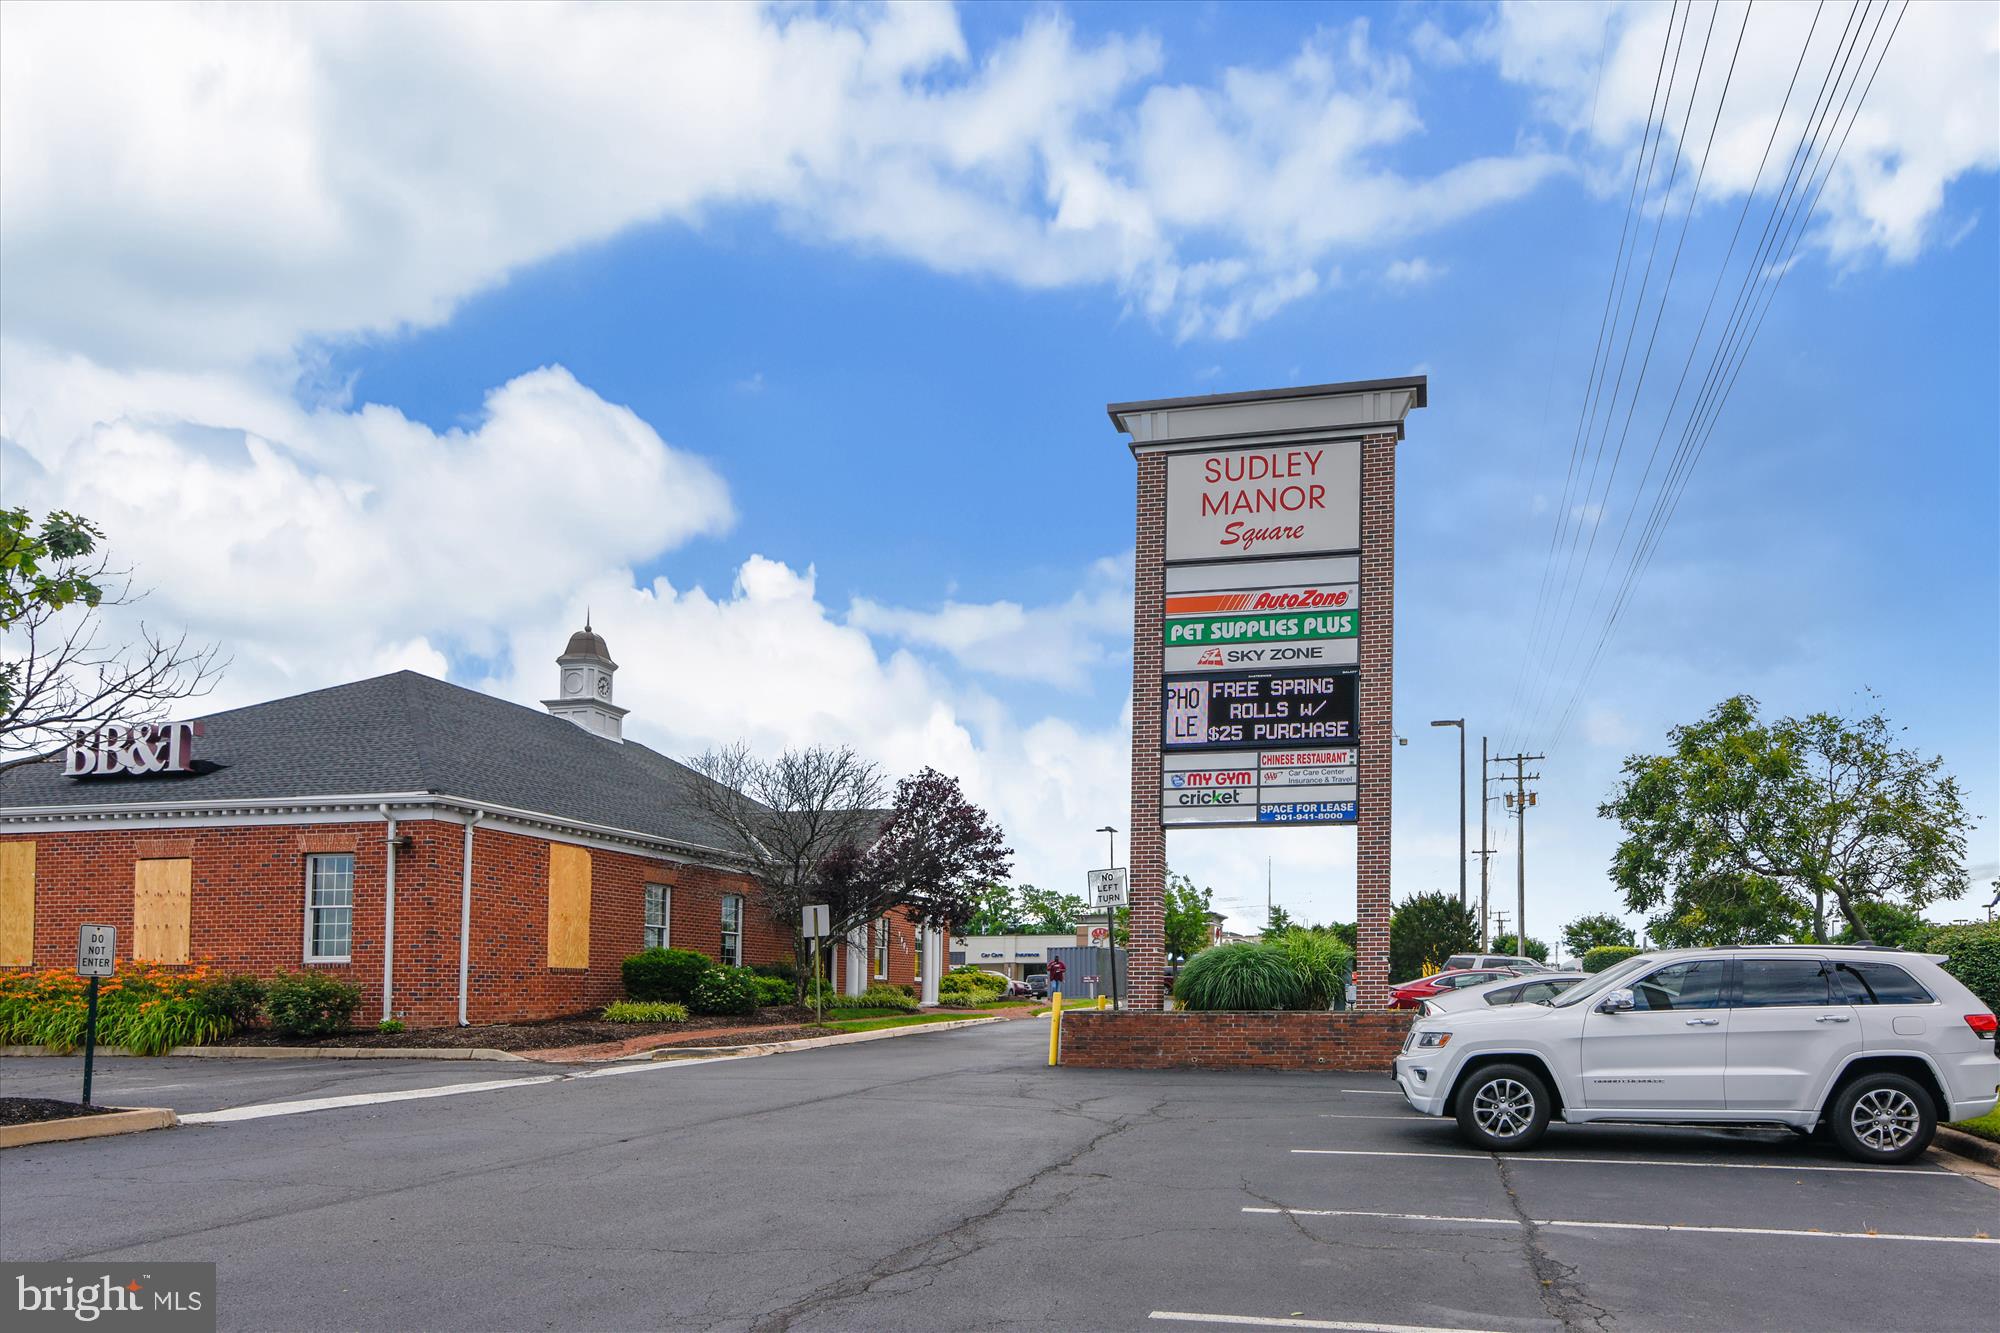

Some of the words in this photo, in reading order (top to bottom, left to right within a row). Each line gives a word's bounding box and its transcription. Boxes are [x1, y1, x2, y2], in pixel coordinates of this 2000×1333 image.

[1204, 450, 1324, 484] SUDLEY
[1201, 485, 1326, 517] MANOR
[1219, 521, 1305, 550] Square
[1252, 589, 1349, 610] AutoZone
[1170, 623, 1205, 642] PET
[1210, 618, 1299, 639] SUPPLIES
[1303, 615, 1352, 635] PLUS
[1227, 649, 1265, 662] SKY
[1269, 647, 1323, 661] ZONE
[1212, 681, 1259, 698] FREE
[1270, 677, 1334, 696] SPRING
[1167, 687, 1200, 710] PHO
[1230, 702, 1289, 719] ROLLS
[1175, 715, 1198, 737] LE
[1208, 725, 1243, 742] $25
[1254, 721, 1349, 740] PURCHASE
[61, 721, 194, 775] BB&T
[1261, 754, 1295, 766] CHINESE
[1296, 752, 1348, 765] RESTAURANT
[1187, 772, 1212, 786] MY
[1215, 771, 1252, 786] GYM
[1288, 769, 1301, 777] Car
[1302, 769, 1320, 777] Care
[1321, 768, 1345, 776] Center
[1331, 775, 1353, 783] Travel
[1179, 789, 1240, 805] cricket
[1260, 804, 1294, 814] SPACE
[1296, 803, 1317, 813] FOR
[1320, 802, 1354, 812] LEASE
[1101, 872, 1114, 882] NO
[1097, 883, 1119, 893] LEFT
[1097, 893, 1120, 903] TURN
[91, 934, 105, 944] DO
[88, 946, 106, 956] NOT
[82, 957, 110, 968] ENTER
